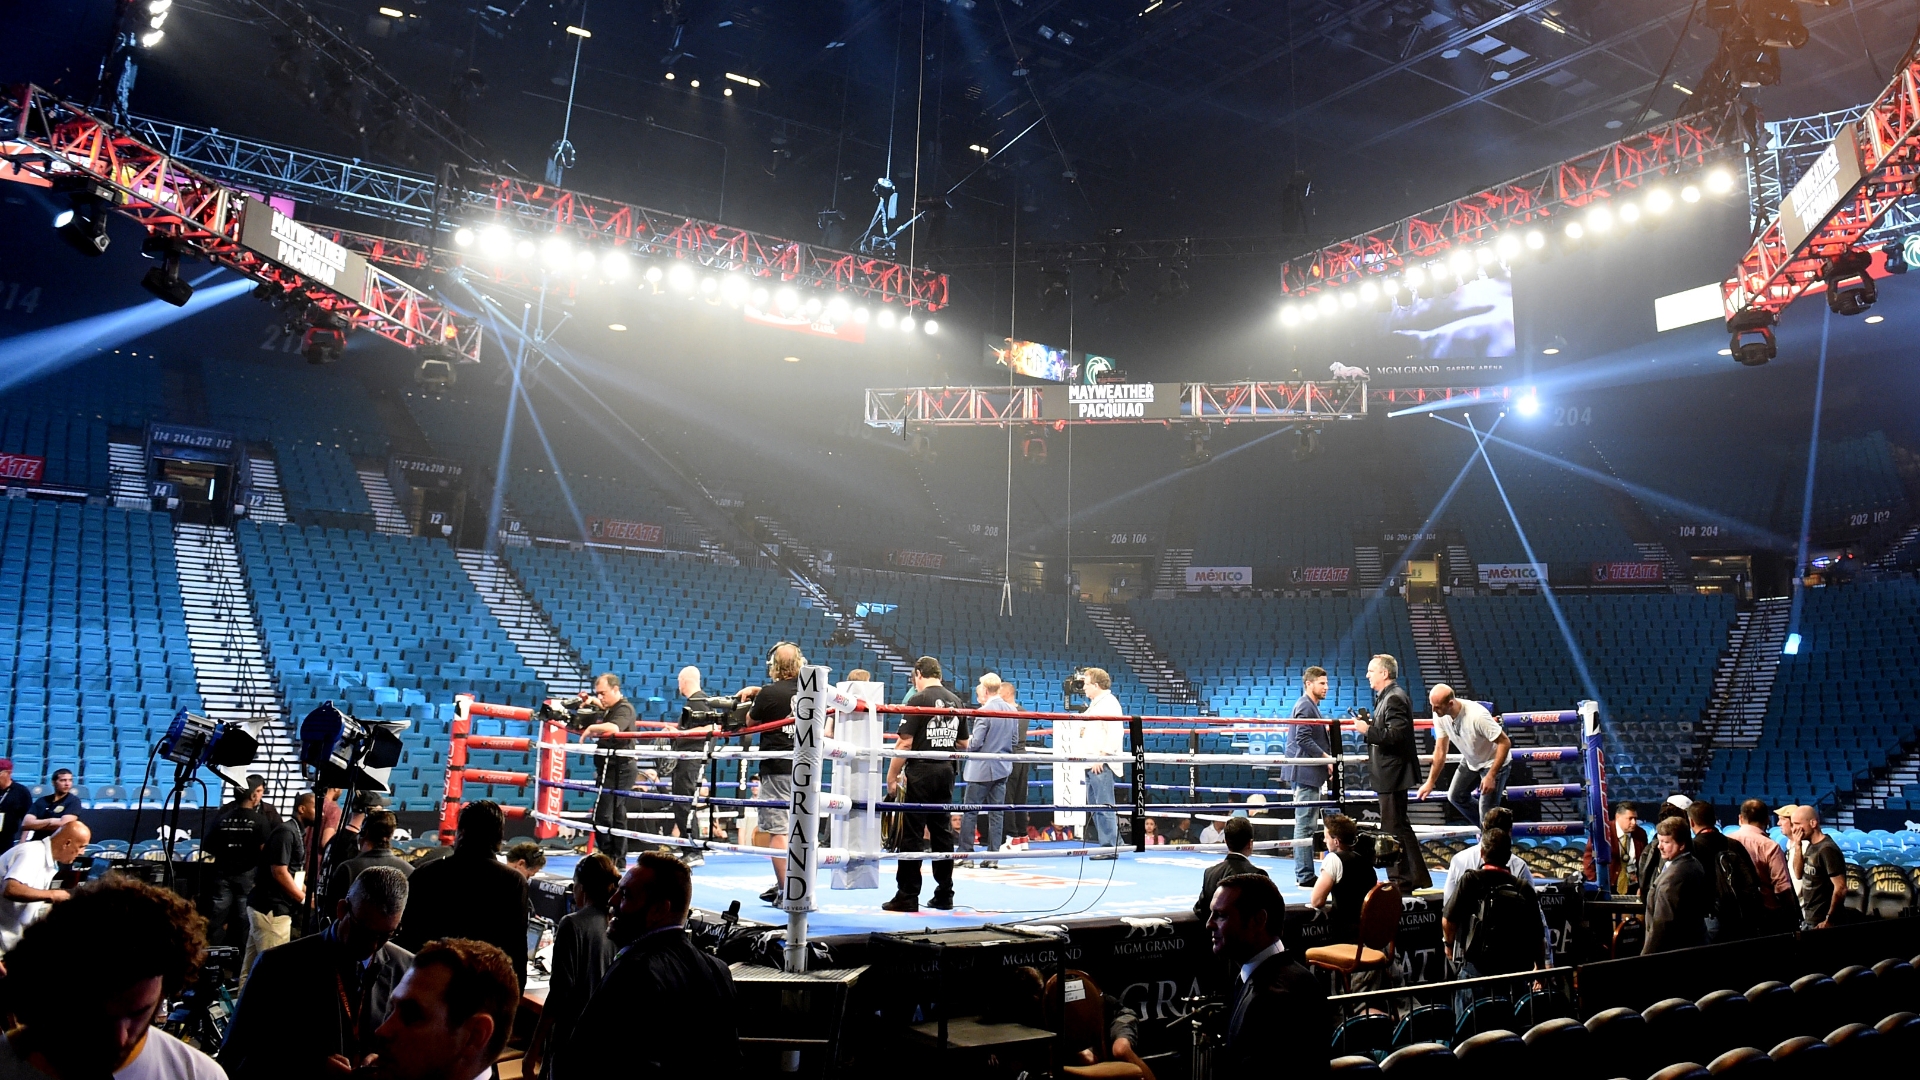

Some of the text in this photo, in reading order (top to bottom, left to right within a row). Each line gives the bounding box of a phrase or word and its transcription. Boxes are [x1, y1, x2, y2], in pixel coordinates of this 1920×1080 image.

[271, 211, 347, 267] MAYWEATHER
[0, 283, 42, 313] 14
[1377, 367, 1402, 375] MGM
[1404, 365, 1440, 374] GRAND
[1068, 384, 1154, 400] MAYWEATHER
[1079, 403, 1143, 418] PACQUIAO
[1554, 407, 1592, 427] 204
[153, 431, 170, 441] 114
[0, 454, 41, 480] ATE
[154, 485, 168, 497] 14
[249, 495, 262, 507] 12
[430, 513, 442, 525] 12
[510, 521, 520, 531] 10
[1850, 513, 1868, 525] 202
[606, 520, 663, 542] TECATE
[984, 525, 999, 537] 208
[1680, 526, 1719, 537] 104 204
[1110, 534, 1147, 544] 206 106
[900, 551, 943, 569] TECATE
[1304, 567, 1350, 582] TECATE
[1610, 563, 1659, 579] TECATE
[796, 668, 820, 749] MGM
[1530, 713, 1561, 723] TECATE
[1136, 744, 1144, 771] MGM
[1531, 751, 1562, 761] TECATE
[1136, 773, 1145, 817] GRAND
[1534, 787, 1565, 797] TECATE
[786, 762, 814, 902] GRAND
[1537, 824, 1568, 834] TECATE
[1875, 880, 1906, 893] Mlife
[1406, 912, 1436, 925] GRAND
[1114, 939, 1185, 955] MGM GRAND
[1003, 948, 1082, 966] MGM GRND
[1120, 976, 1201, 1022] GRA
